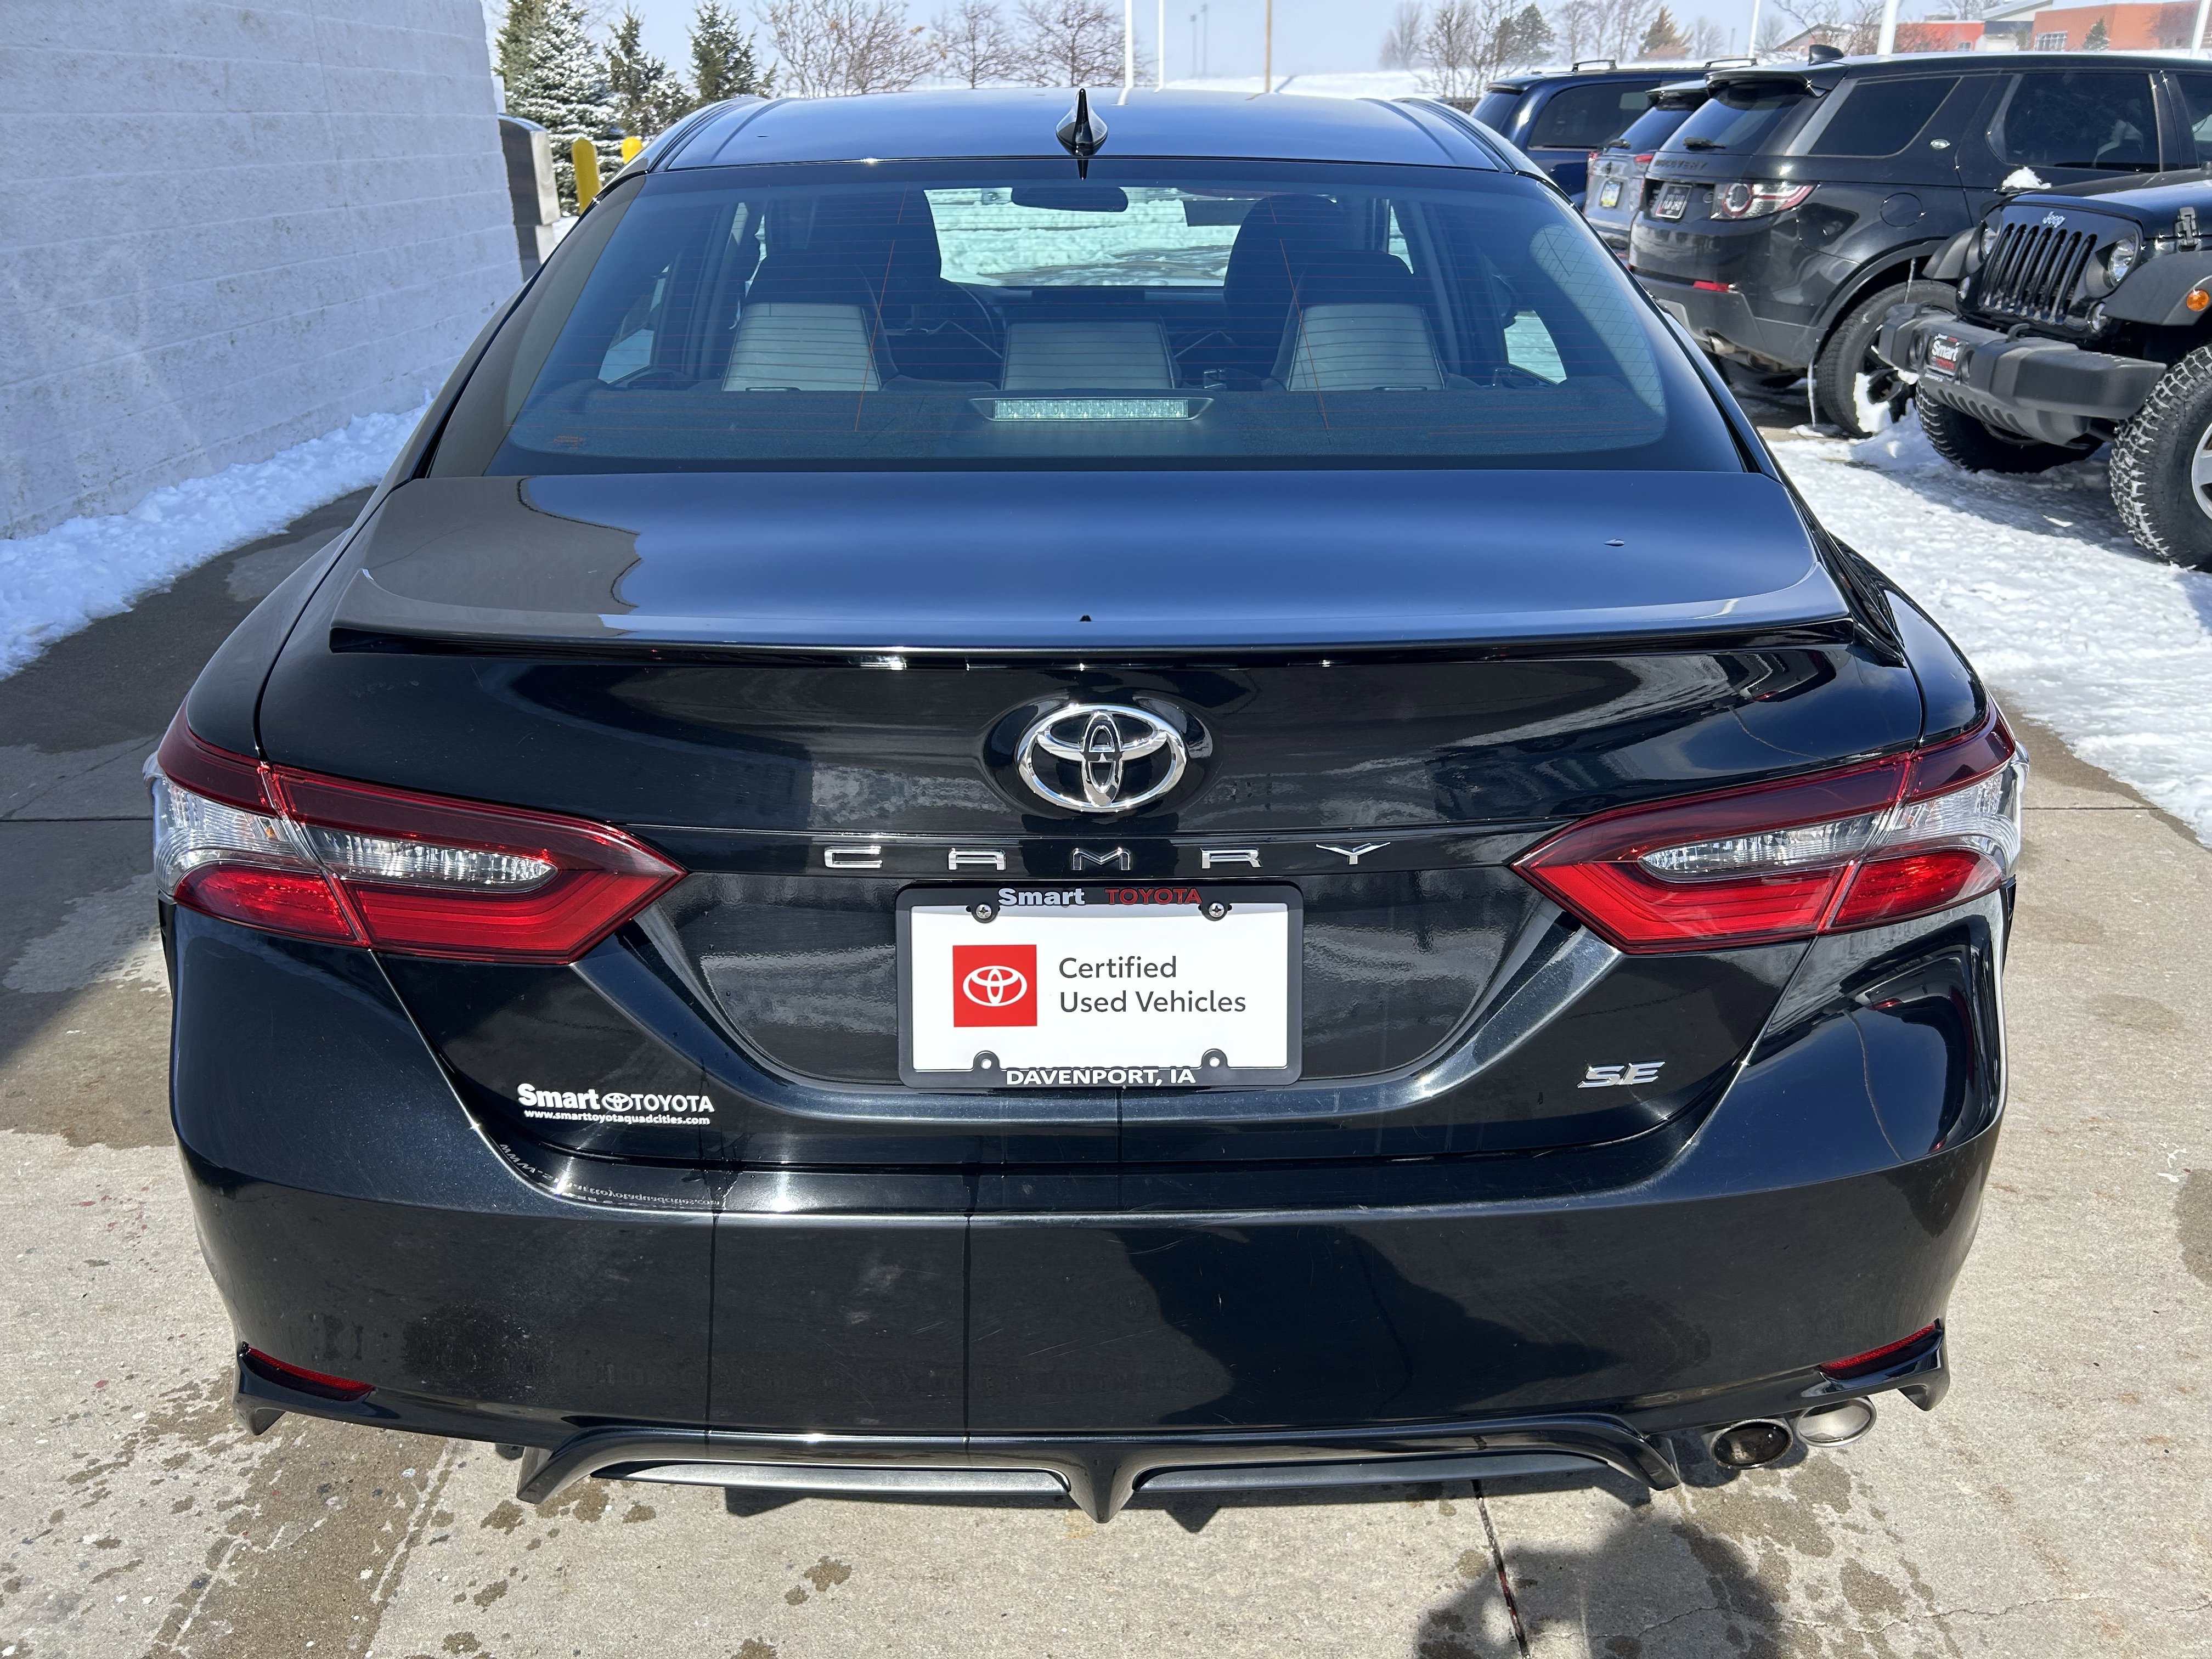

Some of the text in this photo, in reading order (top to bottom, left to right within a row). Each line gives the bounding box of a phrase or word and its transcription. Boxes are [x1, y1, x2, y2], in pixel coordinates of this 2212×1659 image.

[2042, 211, 2066, 228] Jeep
[1932, 340, 1959, 362] Smart
[823, 841, 1391, 871] CAMRY
[998, 888, 1203, 906] Smart TOYOTA
[1059, 956, 1177, 978] Certified
[1060, 990, 1246, 1013] Used Vehicles
[1006, 1069, 1197, 1086] DAVENPORT, IA
[1577, 1061, 1666, 1088] SE
[517, 1083, 715, 1113] Smart TOYOTA
[524, 1110, 710, 1125] www.smarttoyotaquadcities.com
